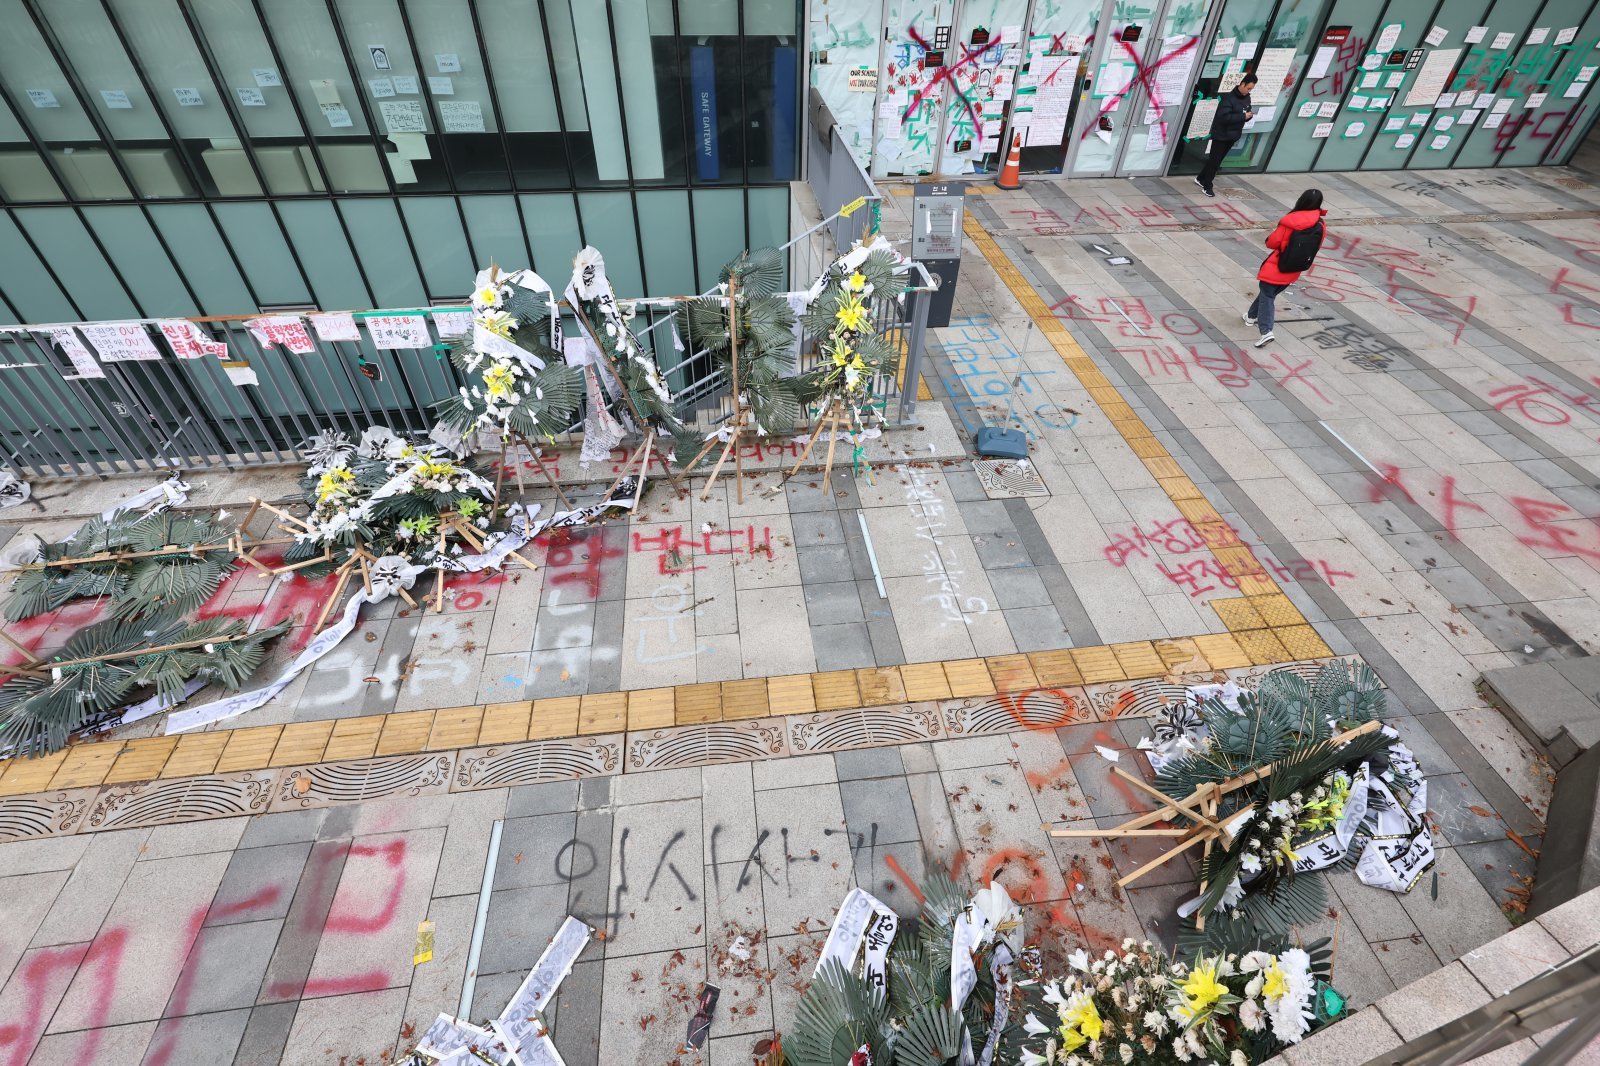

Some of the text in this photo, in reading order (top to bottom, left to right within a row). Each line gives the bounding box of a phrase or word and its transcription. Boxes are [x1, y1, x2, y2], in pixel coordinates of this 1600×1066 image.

[701, 92, 712, 157] SAFE GATEWAY
[1010, 202, 1256, 236] 결사반대
[119, 326, 140, 336] OUT
[124, 338, 146, 347] OUT
[631, 524, 776, 576] 반대
